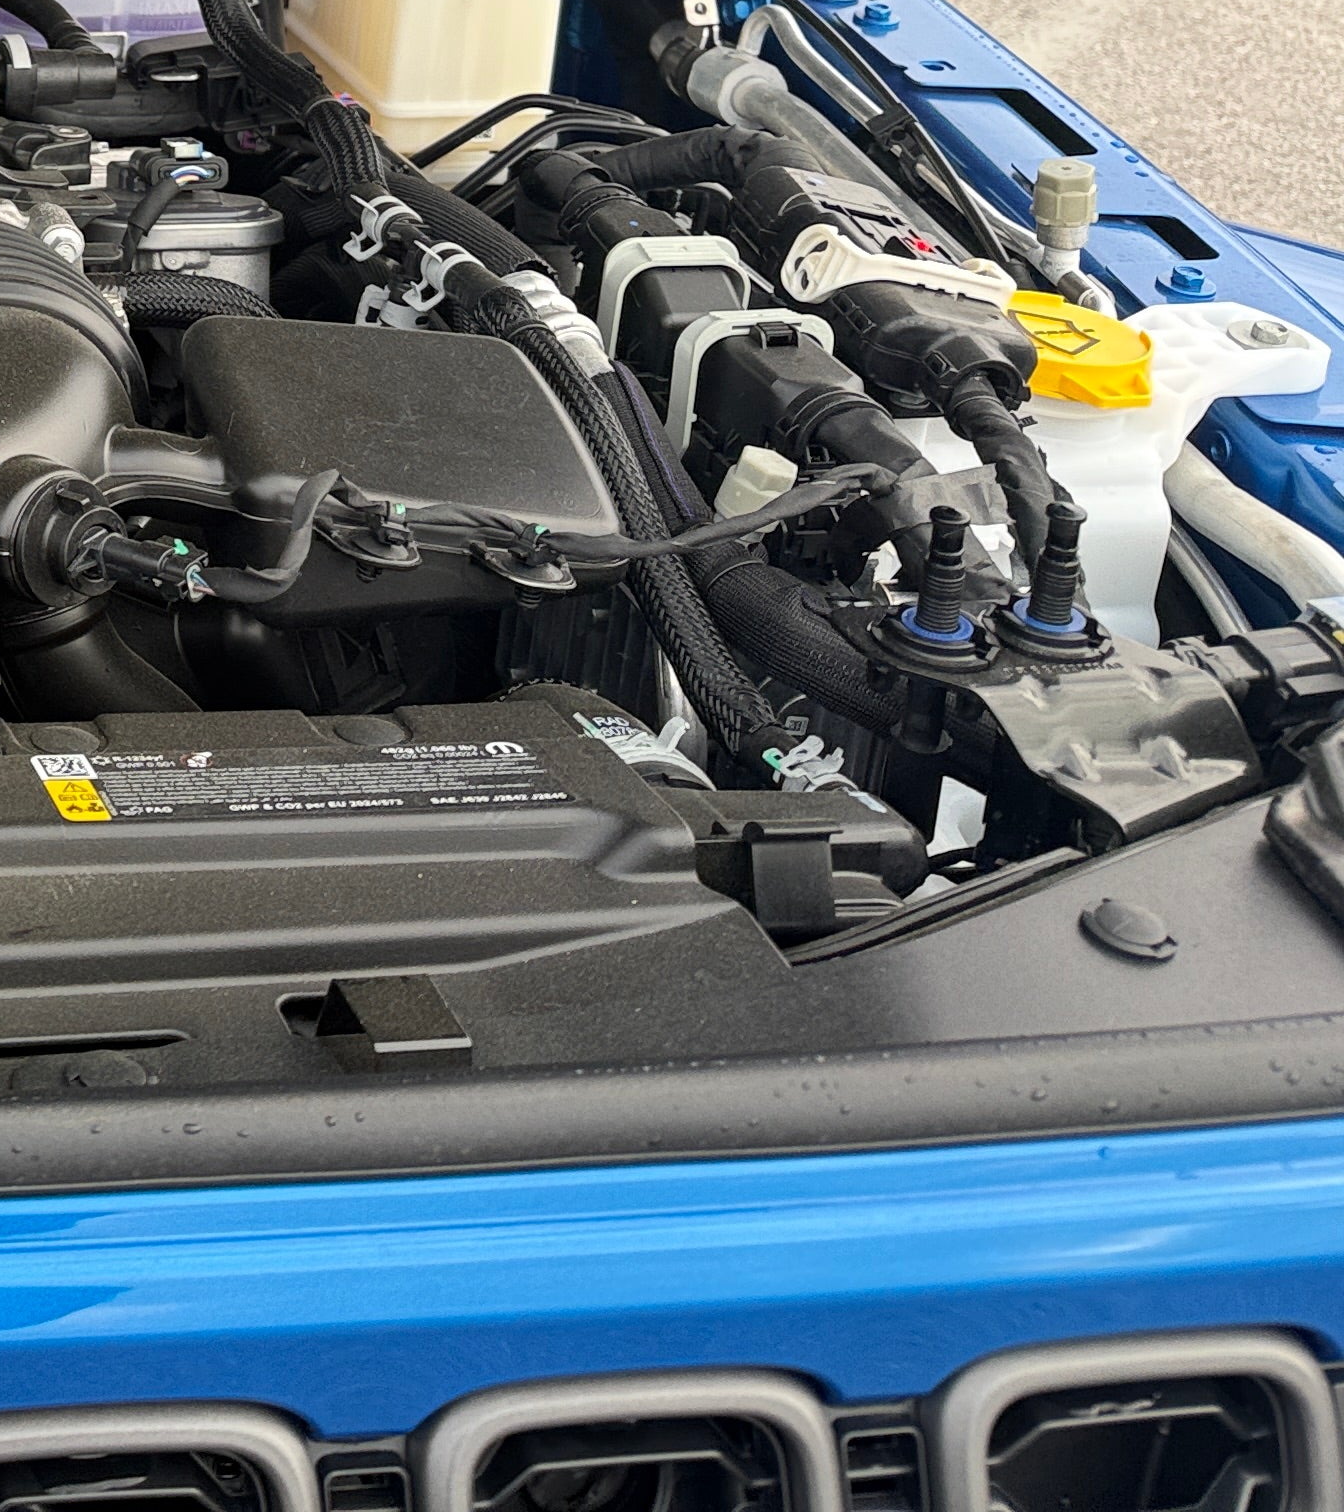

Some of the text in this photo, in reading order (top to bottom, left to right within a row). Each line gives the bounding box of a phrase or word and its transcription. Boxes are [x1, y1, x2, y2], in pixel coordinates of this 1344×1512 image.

[592, 716, 629, 727] RAD
[228, 803, 260, 812] GWP
[304, 801, 326, 811] per
[327, 800, 347, 809] EU
[430, 796, 459, 805] SAE
